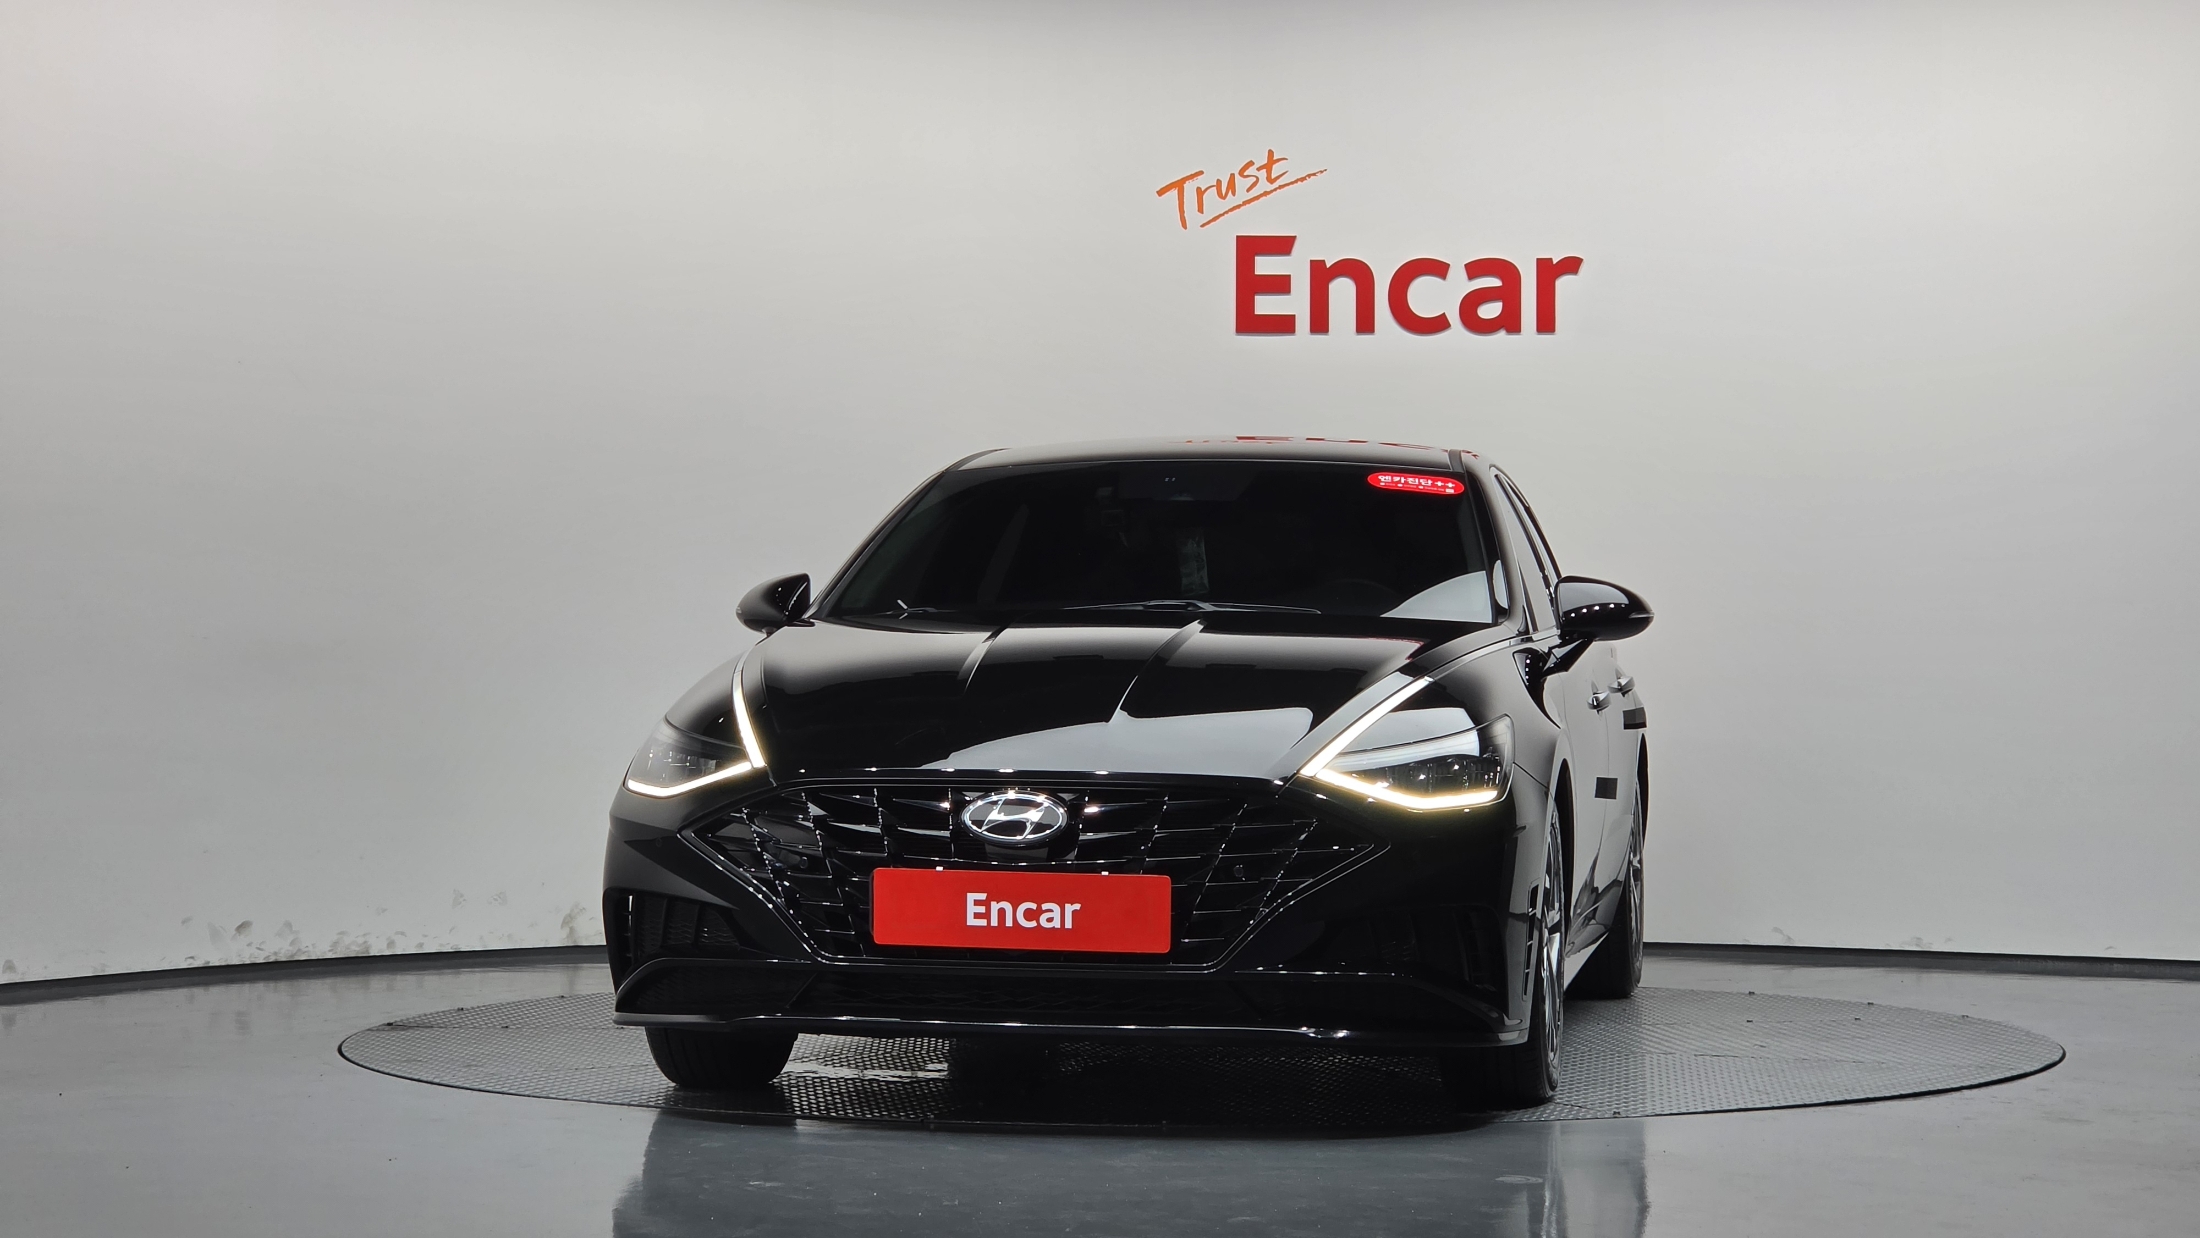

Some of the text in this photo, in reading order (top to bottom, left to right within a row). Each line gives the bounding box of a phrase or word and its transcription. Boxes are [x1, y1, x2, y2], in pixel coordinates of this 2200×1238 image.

[1156, 149, 1289, 230] Trust
[1235, 235, 1584, 335] Encar
[965, 892, 1082, 929] Encar
